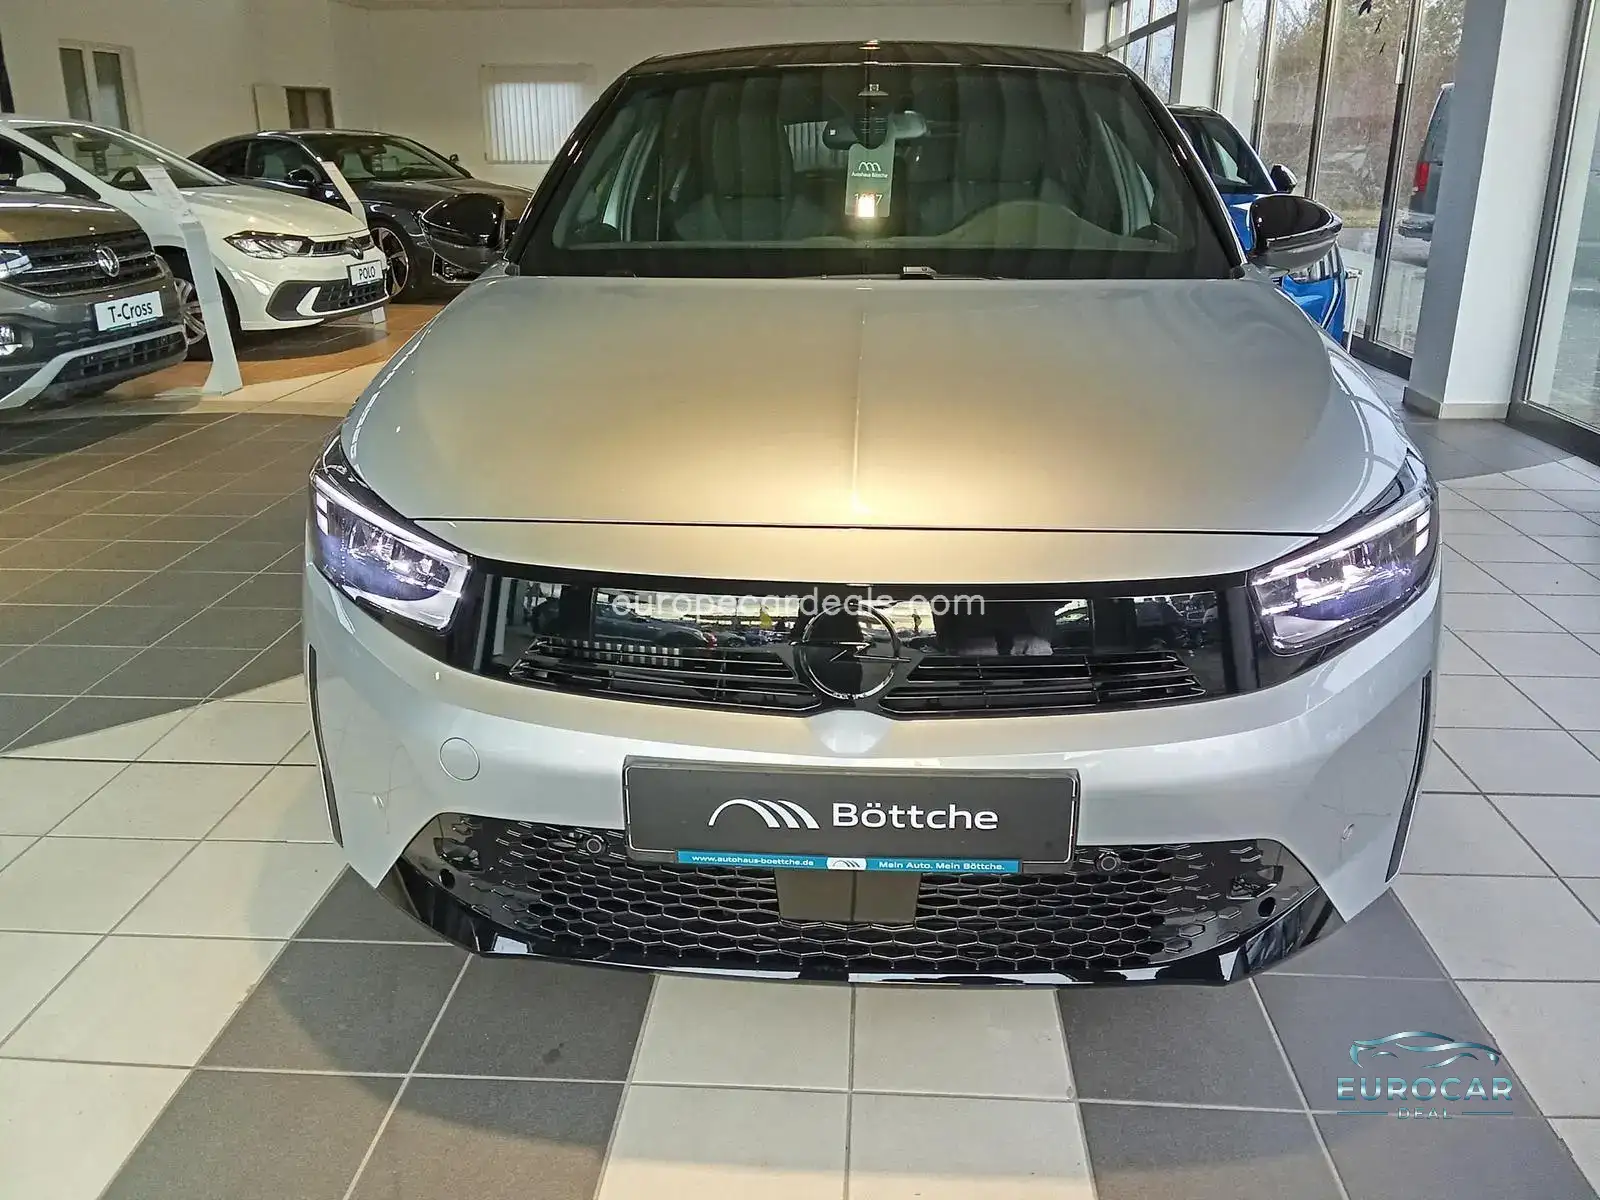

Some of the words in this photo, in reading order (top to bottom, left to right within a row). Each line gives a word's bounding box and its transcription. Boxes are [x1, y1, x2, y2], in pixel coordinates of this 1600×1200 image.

[359, 266, 376, 280] POLO
[107, 302, 153, 323] T-Cross
[832, 802, 999, 830] Böttche
[691, 854, 814, 867] www.autohaus-boettche.de
[878, 861, 904, 869] Mein
[906, 862, 933, 870] Auto.
[935, 862, 961, 870] Mein
[963, 862, 1005, 871] Böttche.
